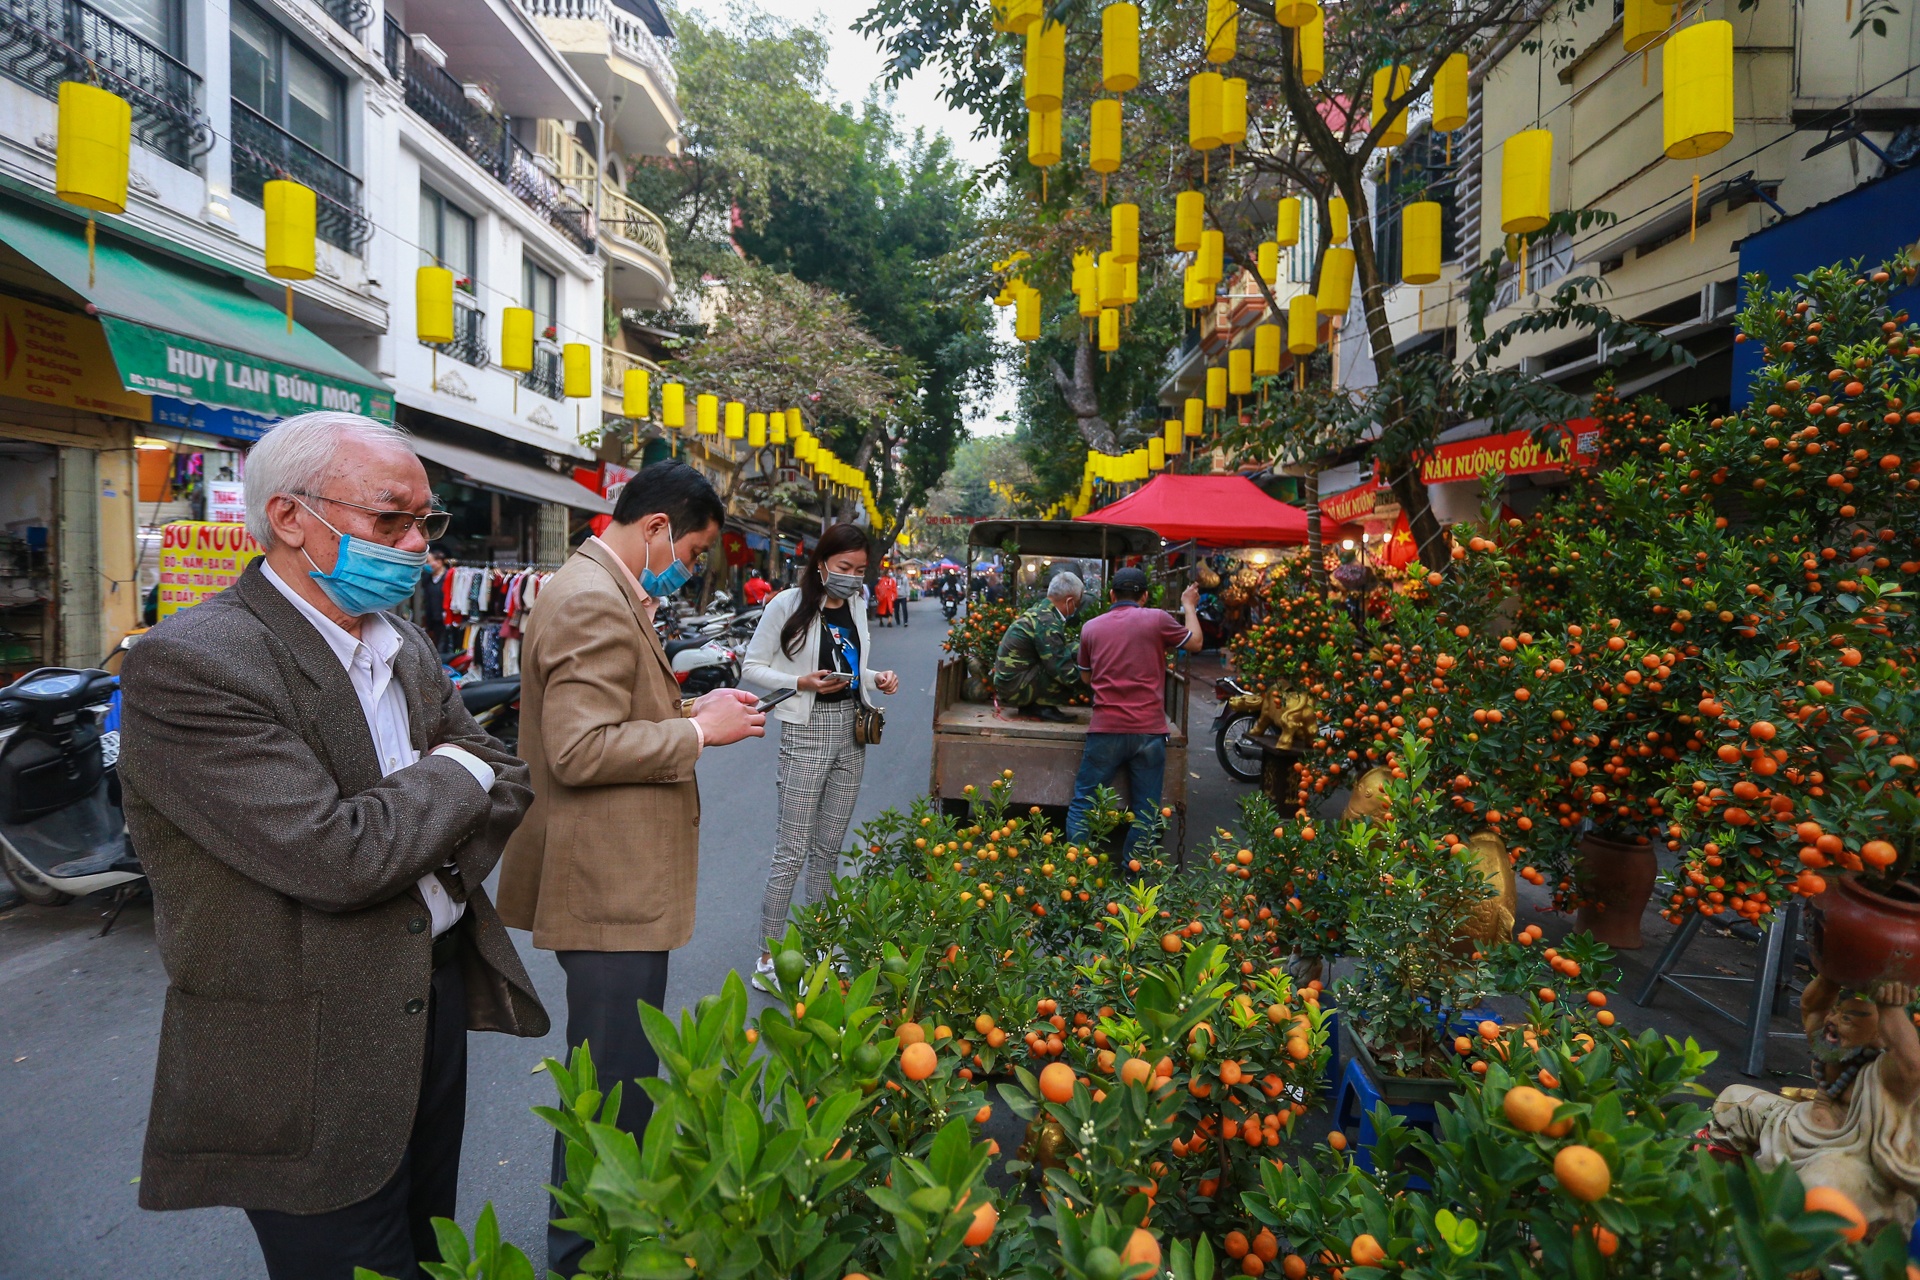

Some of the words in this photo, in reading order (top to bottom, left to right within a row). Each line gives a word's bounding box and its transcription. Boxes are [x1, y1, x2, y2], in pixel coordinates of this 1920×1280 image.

[167, 346, 218, 382] HUY
[224, 360, 270, 395] LAN
[275, 374, 318, 405] BÚN
